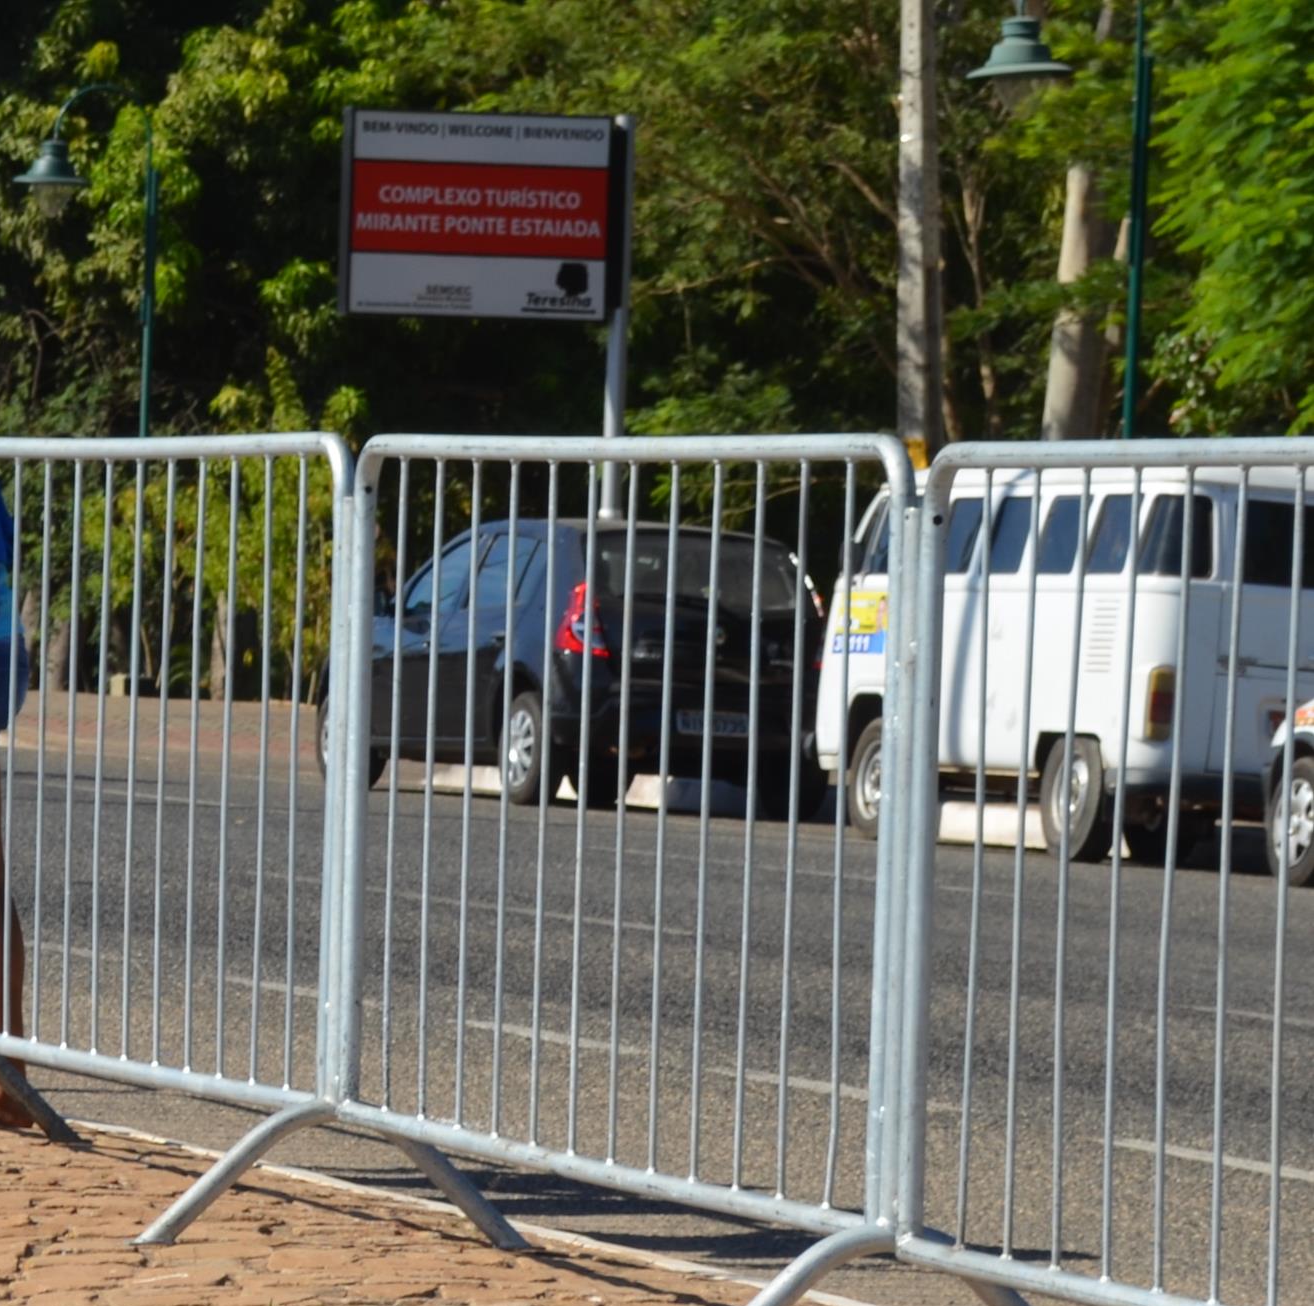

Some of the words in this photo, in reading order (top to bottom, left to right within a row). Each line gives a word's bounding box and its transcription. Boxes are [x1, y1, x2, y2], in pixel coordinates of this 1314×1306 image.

[362, 120, 438, 135] BEM-VINDO
[448, 125, 512, 138] WELCOME
[523, 126, 605, 142] BIENVENIDO
[379, 185, 481, 206] COMPLEXO
[485, 186, 581, 210] TURÍSTICO
[356, 212, 440, 233] MIRANTE
[444, 215, 506, 235] PONTE
[511, 218, 601, 238] ESTAIADA
[525, 291, 593, 309] Teresina
